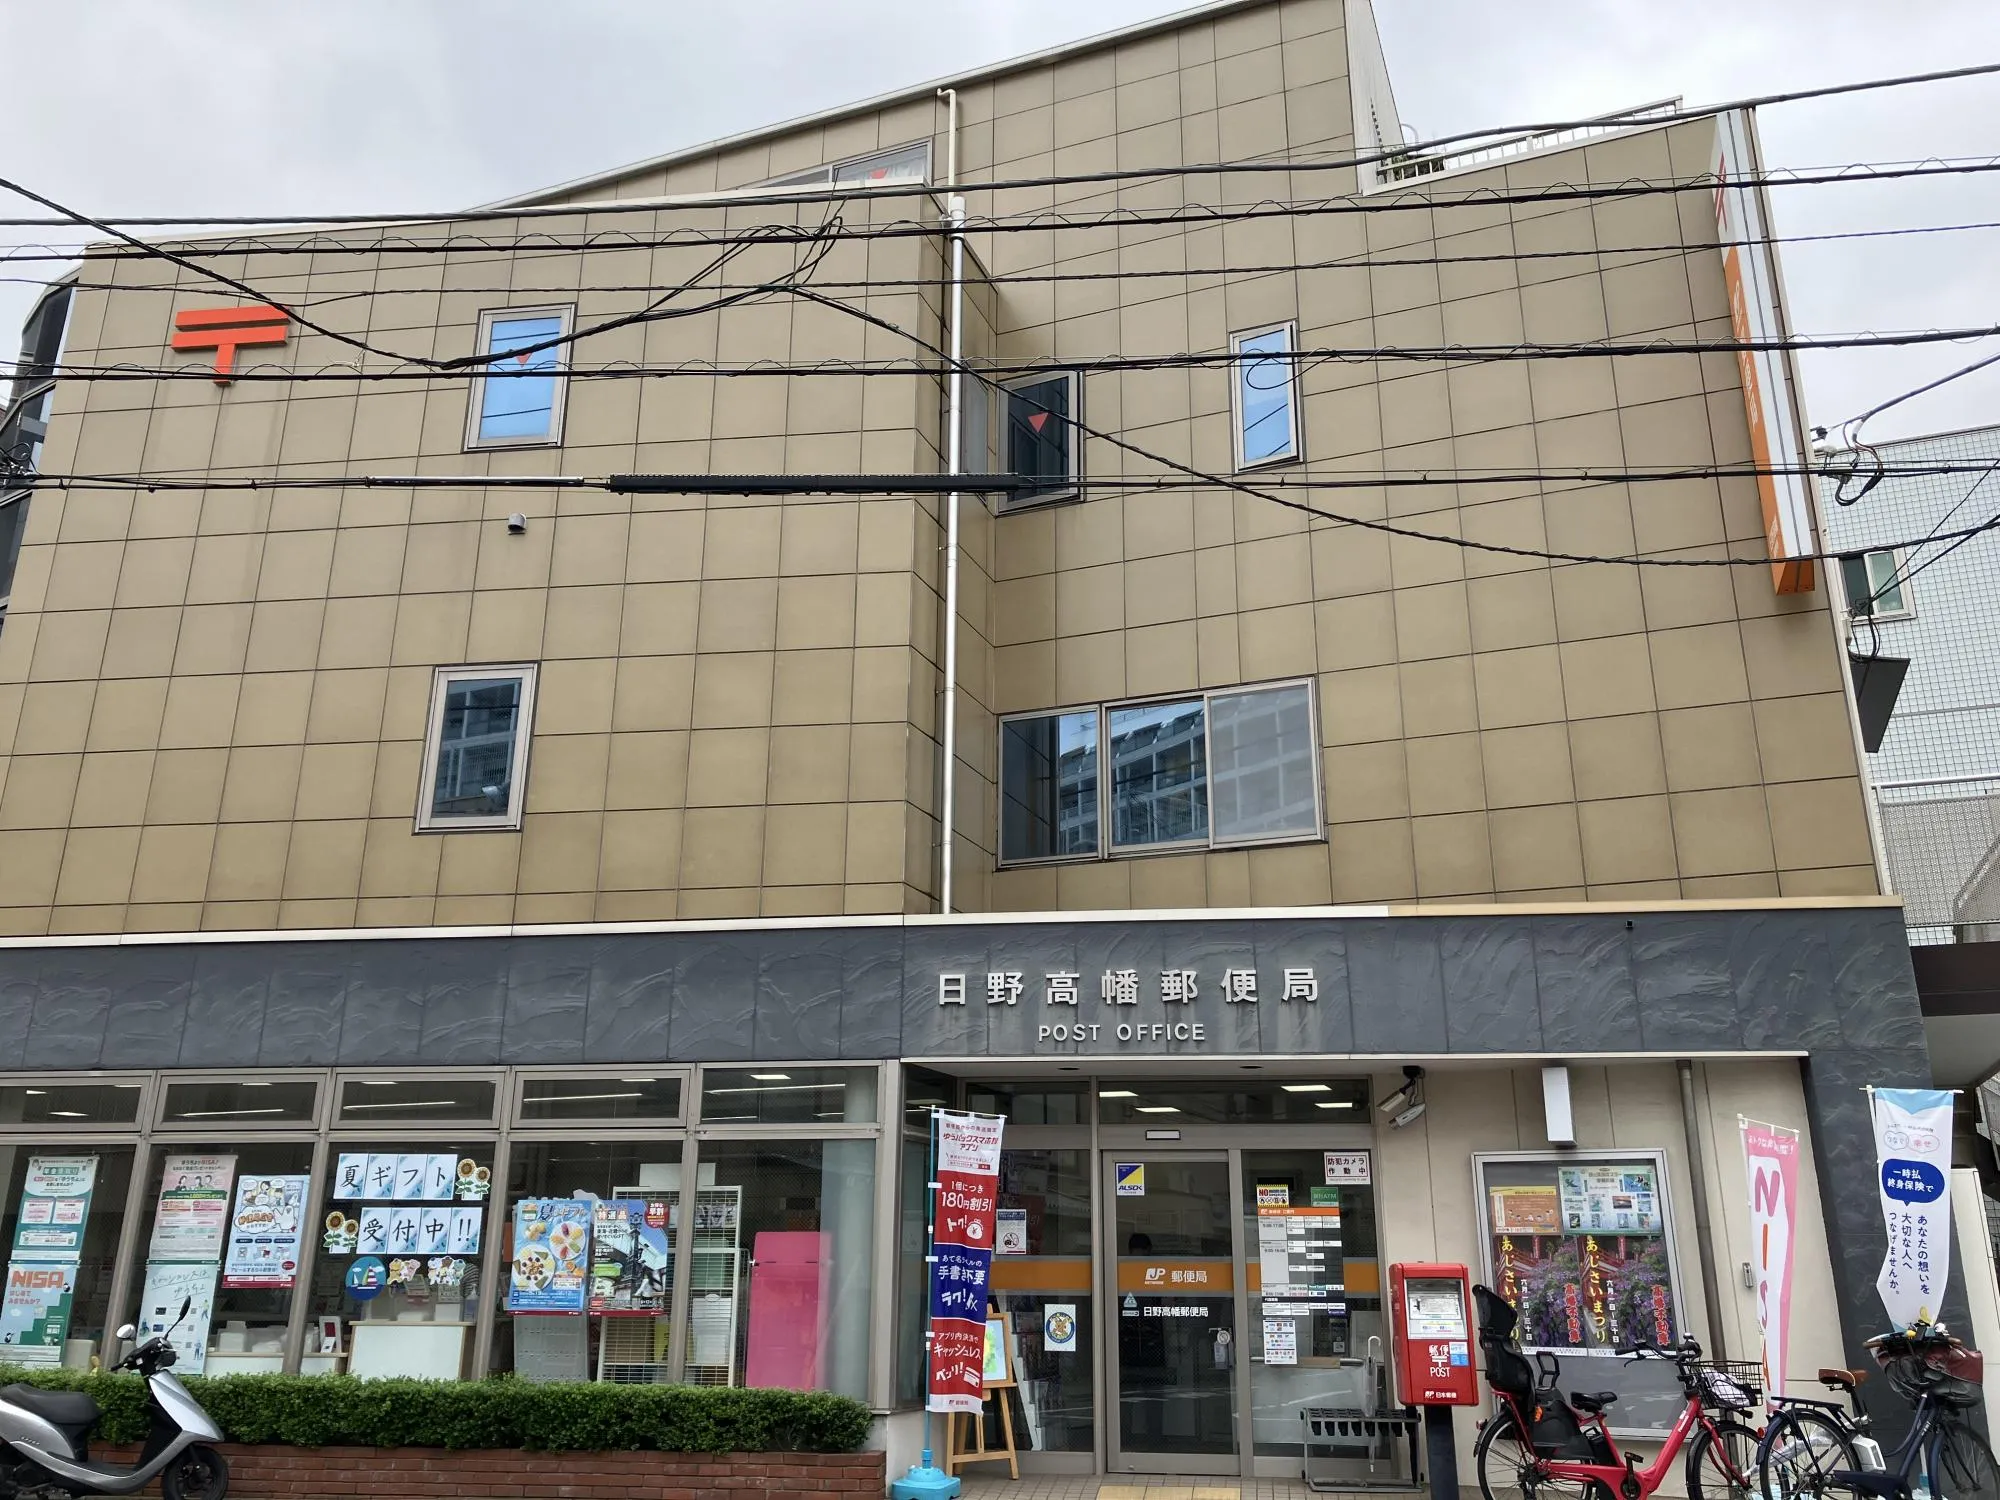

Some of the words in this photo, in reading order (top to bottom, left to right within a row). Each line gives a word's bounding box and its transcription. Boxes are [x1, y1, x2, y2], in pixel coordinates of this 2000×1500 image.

[939, 967, 1319, 1006] 日野高幡郵便局
[1038, 1023, 1101, 1042] POST
[1116, 1022, 1206, 1042] OFFICE
[959, 1143, 979, 1152] アプリ
[1327, 1157, 1365, 1166] 防犯カメラ
[340, 1164, 447, 1188] 夏ギフト
[1328, 1167, 1366, 1175] 作動中
[1892, 1168, 1922, 1180] 一時払
[951, 1180, 984, 1194] 1個につき
[1258, 1188, 1269, 1197] NO
[1887, 1177, 1935, 1193] 終身保険で
[941, 1191, 993, 1212] 180円割引
[362, 1217, 472, 1243] 受付中!!
[946, 1214, 968, 1233] トク!
[1901, 1212, 1913, 1270] 大切な人へ
[1888, 1212, 1900, 1295] つなげませんか。
[1917, 1214, 1930, 1295] あなたの想いを
[11, 1270, 64, 1289] NISA
[938, 1265, 986, 1286] 手書き不要
[1171, 1270, 1207, 1283] 郵便局
[941, 1288, 966, 1306] ラク!
[1586, 1238, 1607, 1344] あじさいまつり
[1143, 1306, 1209, 1318] 日野高幡郵便局
[938, 1331, 979, 1344] アプリ内決済で
[933, 1342, 981, 1360] キャッシュレス
[1428, 1344, 1450, 1357] 郵便
[935, 1361, 964, 1381] ベンリ!
[1429, 1366, 1451, 1378] POST
